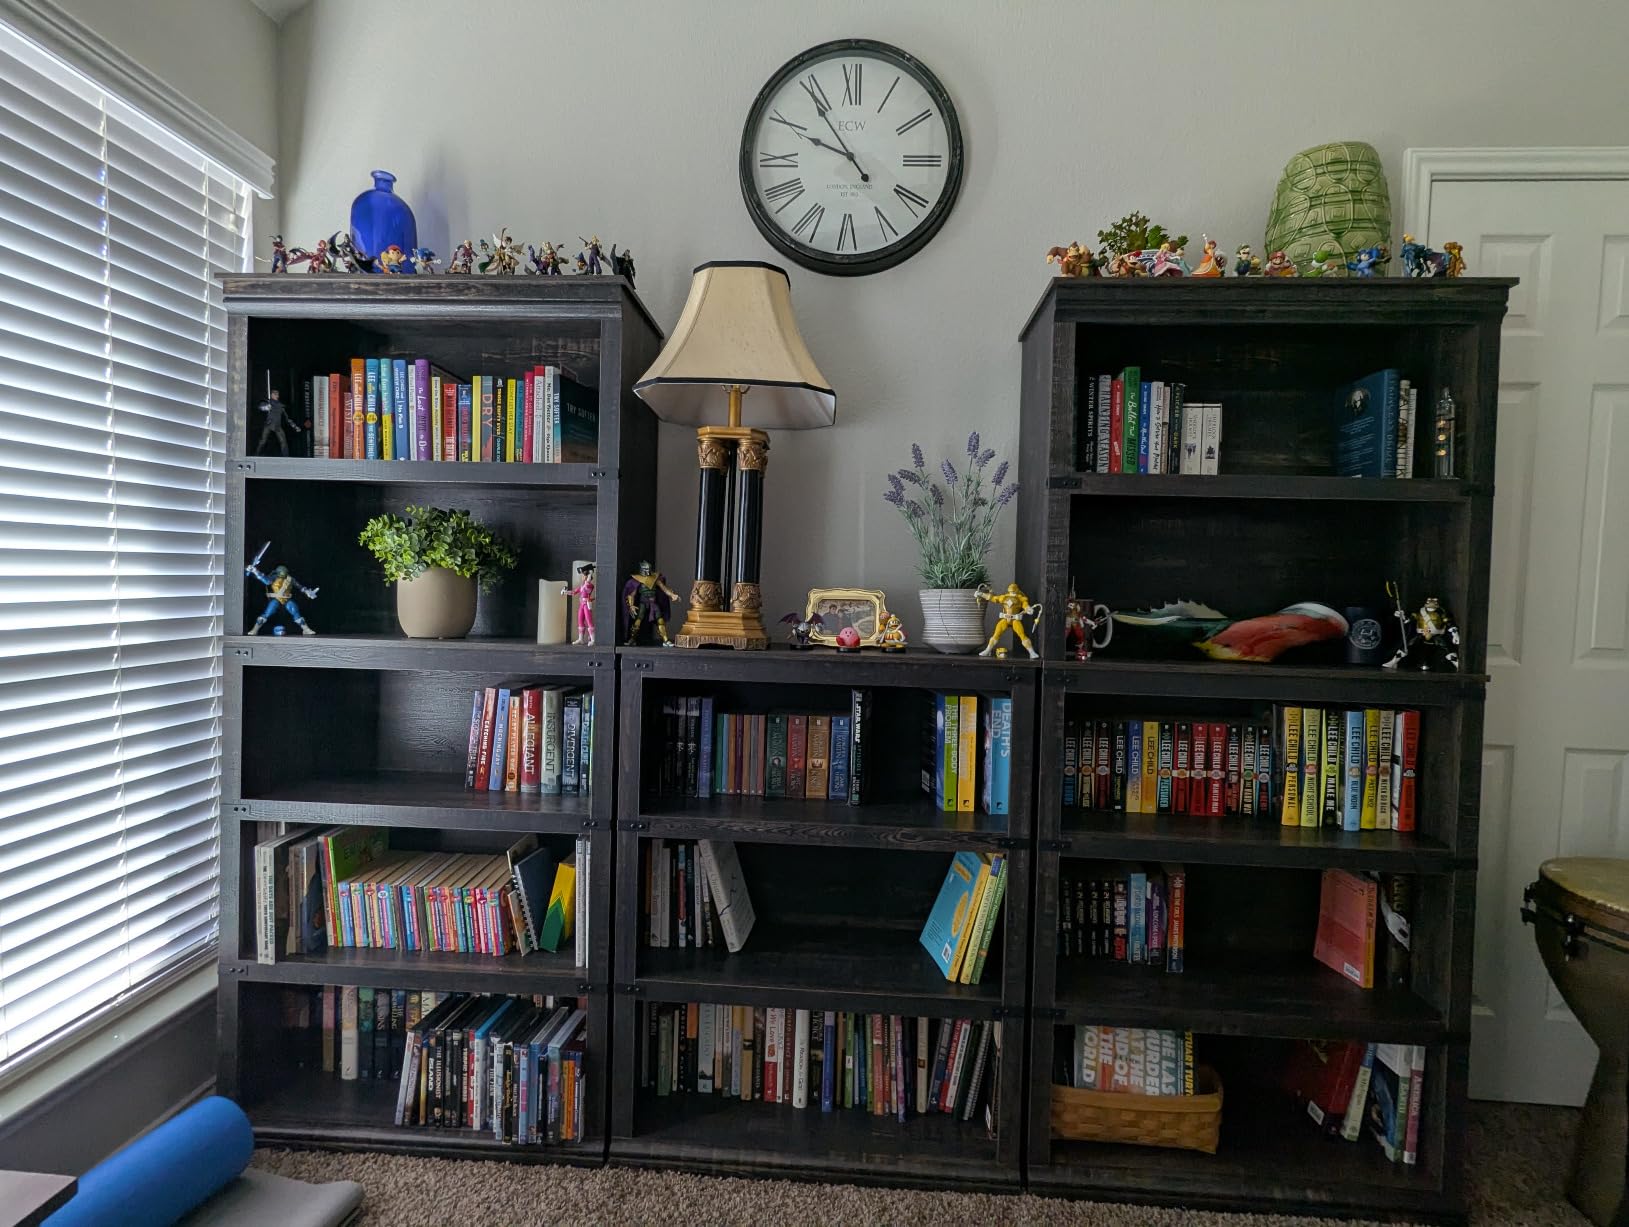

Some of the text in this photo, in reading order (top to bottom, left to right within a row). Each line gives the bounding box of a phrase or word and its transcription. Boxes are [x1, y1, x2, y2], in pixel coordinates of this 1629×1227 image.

[842, 63, 862, 106] XII
[838, 120, 866, 132] ECW
[903, 155, 942, 167] III
[354, 373, 363, 383] LEE
[368, 371, 376, 383] LEE
[368, 394, 377, 412] CHILD
[482, 393, 493, 428] DRY
[1128, 400, 1138, 425] Bullet
[1099, 390, 1111, 468] HAUNTING SEASON
[1127, 437, 1137, 466] MISSED
[483, 720, 491, 750] CATCHING
[582, 721, 590, 744] DEATH
[992, 710, 1002, 739] END
[1002, 702, 1012, 758] DEATH'S
[1382, 727, 1392, 741] LEE
[496, 723, 505, 767] MOCKINGJAY
[526, 713, 536, 775] ALLEGIANT
[546, 712, 557, 774] INSURGENT
[566, 723, 577, 779] DIVERGENT
[1083, 738, 1093, 749] LEE
[1099, 738, 1109, 766] LEE CHILD
[1115, 735, 1125, 775] LEE CHILD
[1133, 735, 1142, 750] LEE
[1178, 741, 1188, 769] LEE CHILD
[1195, 741, 1205, 769] LEE CHILD
[1213, 742, 1222, 753] LEE
[1245, 742, 1255, 753] LEE
[1260, 744, 1270, 756] LEE
[1382, 742, 1391, 764] CHILD
[468, 745, 478, 769] TRIALS
[1132, 751, 1140, 775] CHILD
[1213, 753, 1221, 770] CHILD
[1229, 743, 1239, 771] LEE CHILD
[1245, 753, 1254, 770] CHILD
[1260, 756, 1269, 772] CHILD
[1288, 723, 1298, 809] LEE CHILD PERSONAL
[1306, 724, 1316, 817] LEE CHILD NIGHT SCHOOL
[1326, 726, 1338, 811] LEE CHILD MAKE ME
[1351, 726, 1361, 810] LEE CHILD BLUE MOON
[1367, 725, 1379, 809] LEE CHILD PAST TENSE
[1161, 740, 1171, 809] LEE CHILD PERSUADER
[1380, 802, 1388, 814] BACK
[1100, 1032, 1114, 1066] THE
[1114, 1027, 1129, 1087] ND OF
[1130, 1054, 1145, 1088] THE
[1185, 1031, 1194, 1097] STUART TURT
[1161, 1060, 1177, 1097] LAS
[1412, 1075, 1422, 1117] AMERICA
